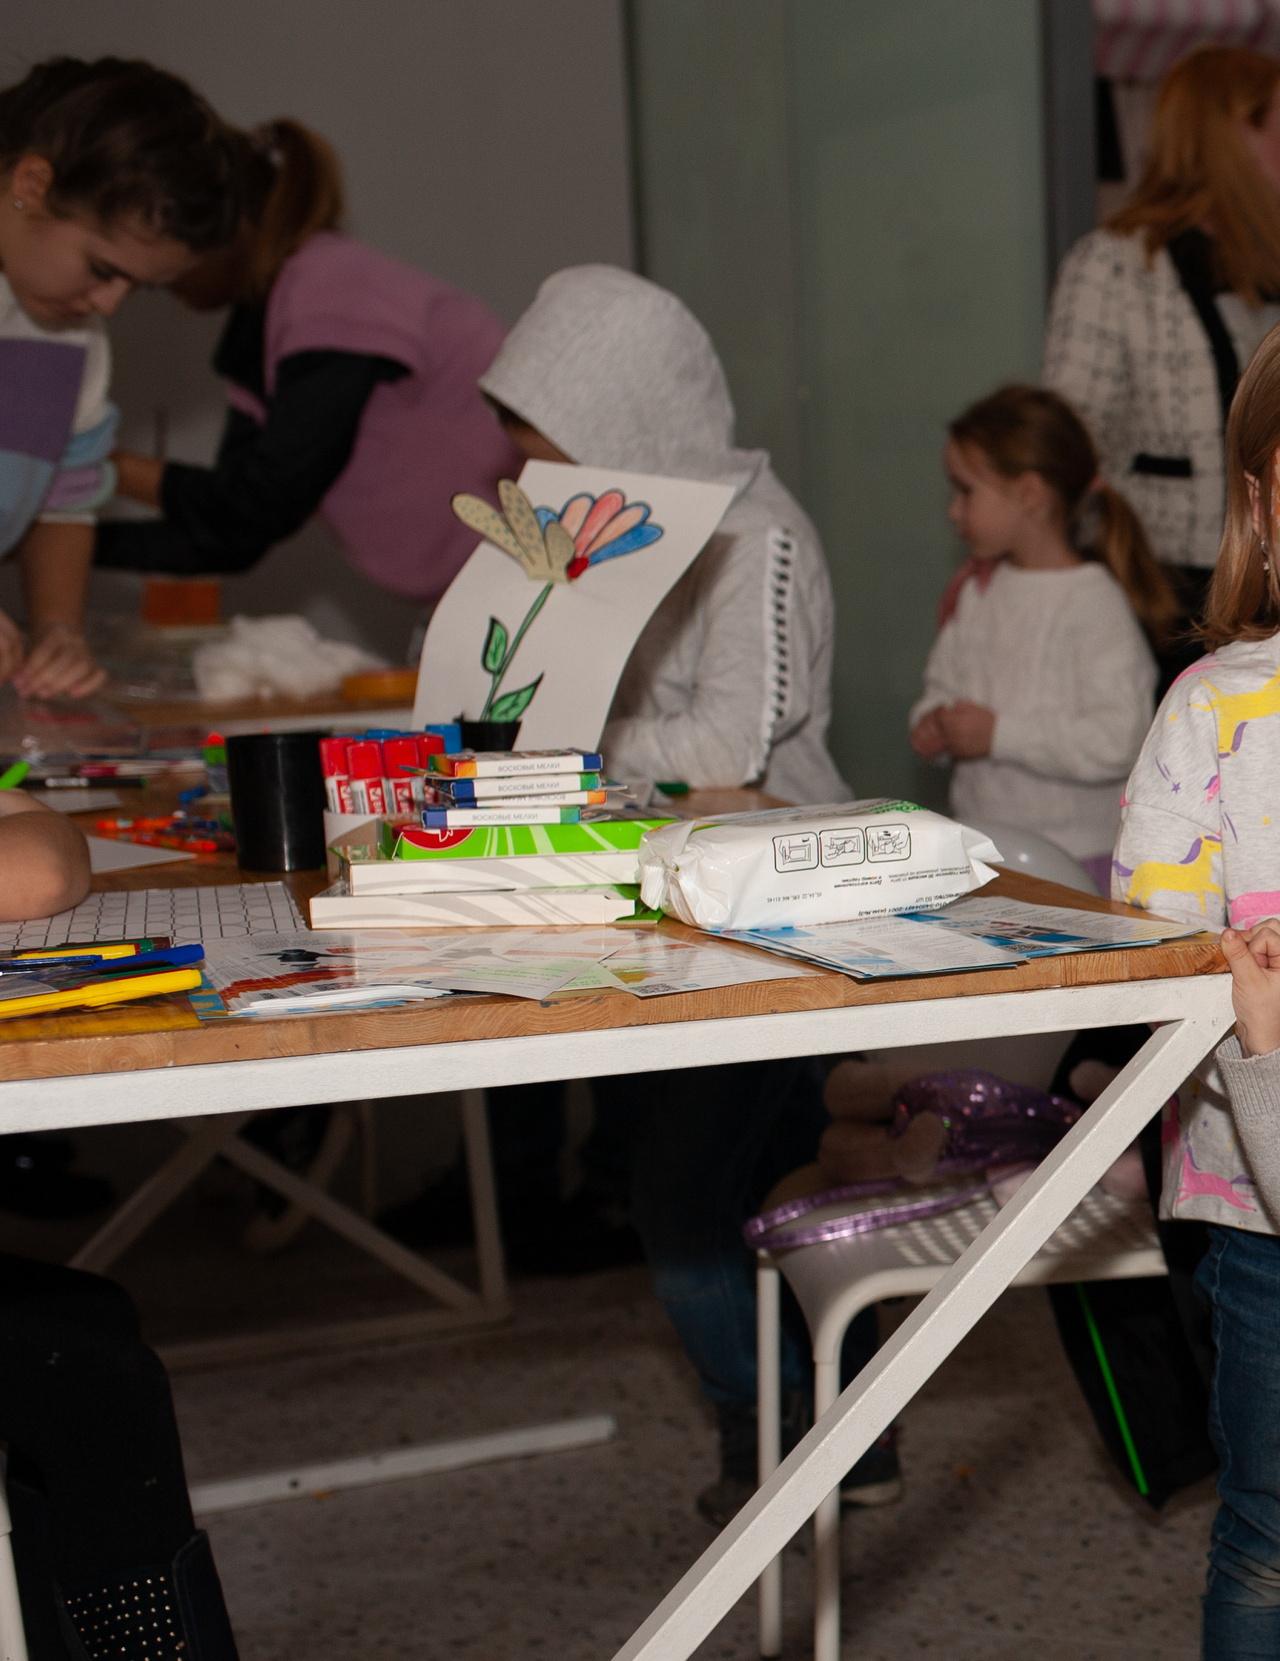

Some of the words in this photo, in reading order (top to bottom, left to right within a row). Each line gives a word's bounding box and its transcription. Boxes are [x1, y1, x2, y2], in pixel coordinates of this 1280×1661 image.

[498, 764, 535, 772] ВОСКОВЫЕ
[536, 762, 560, 770] МЕЛКИ
[498, 784, 535, 792] ВОСКОВЫЕ
[472, 813, 511, 821] ВОСКОВЫЕ
